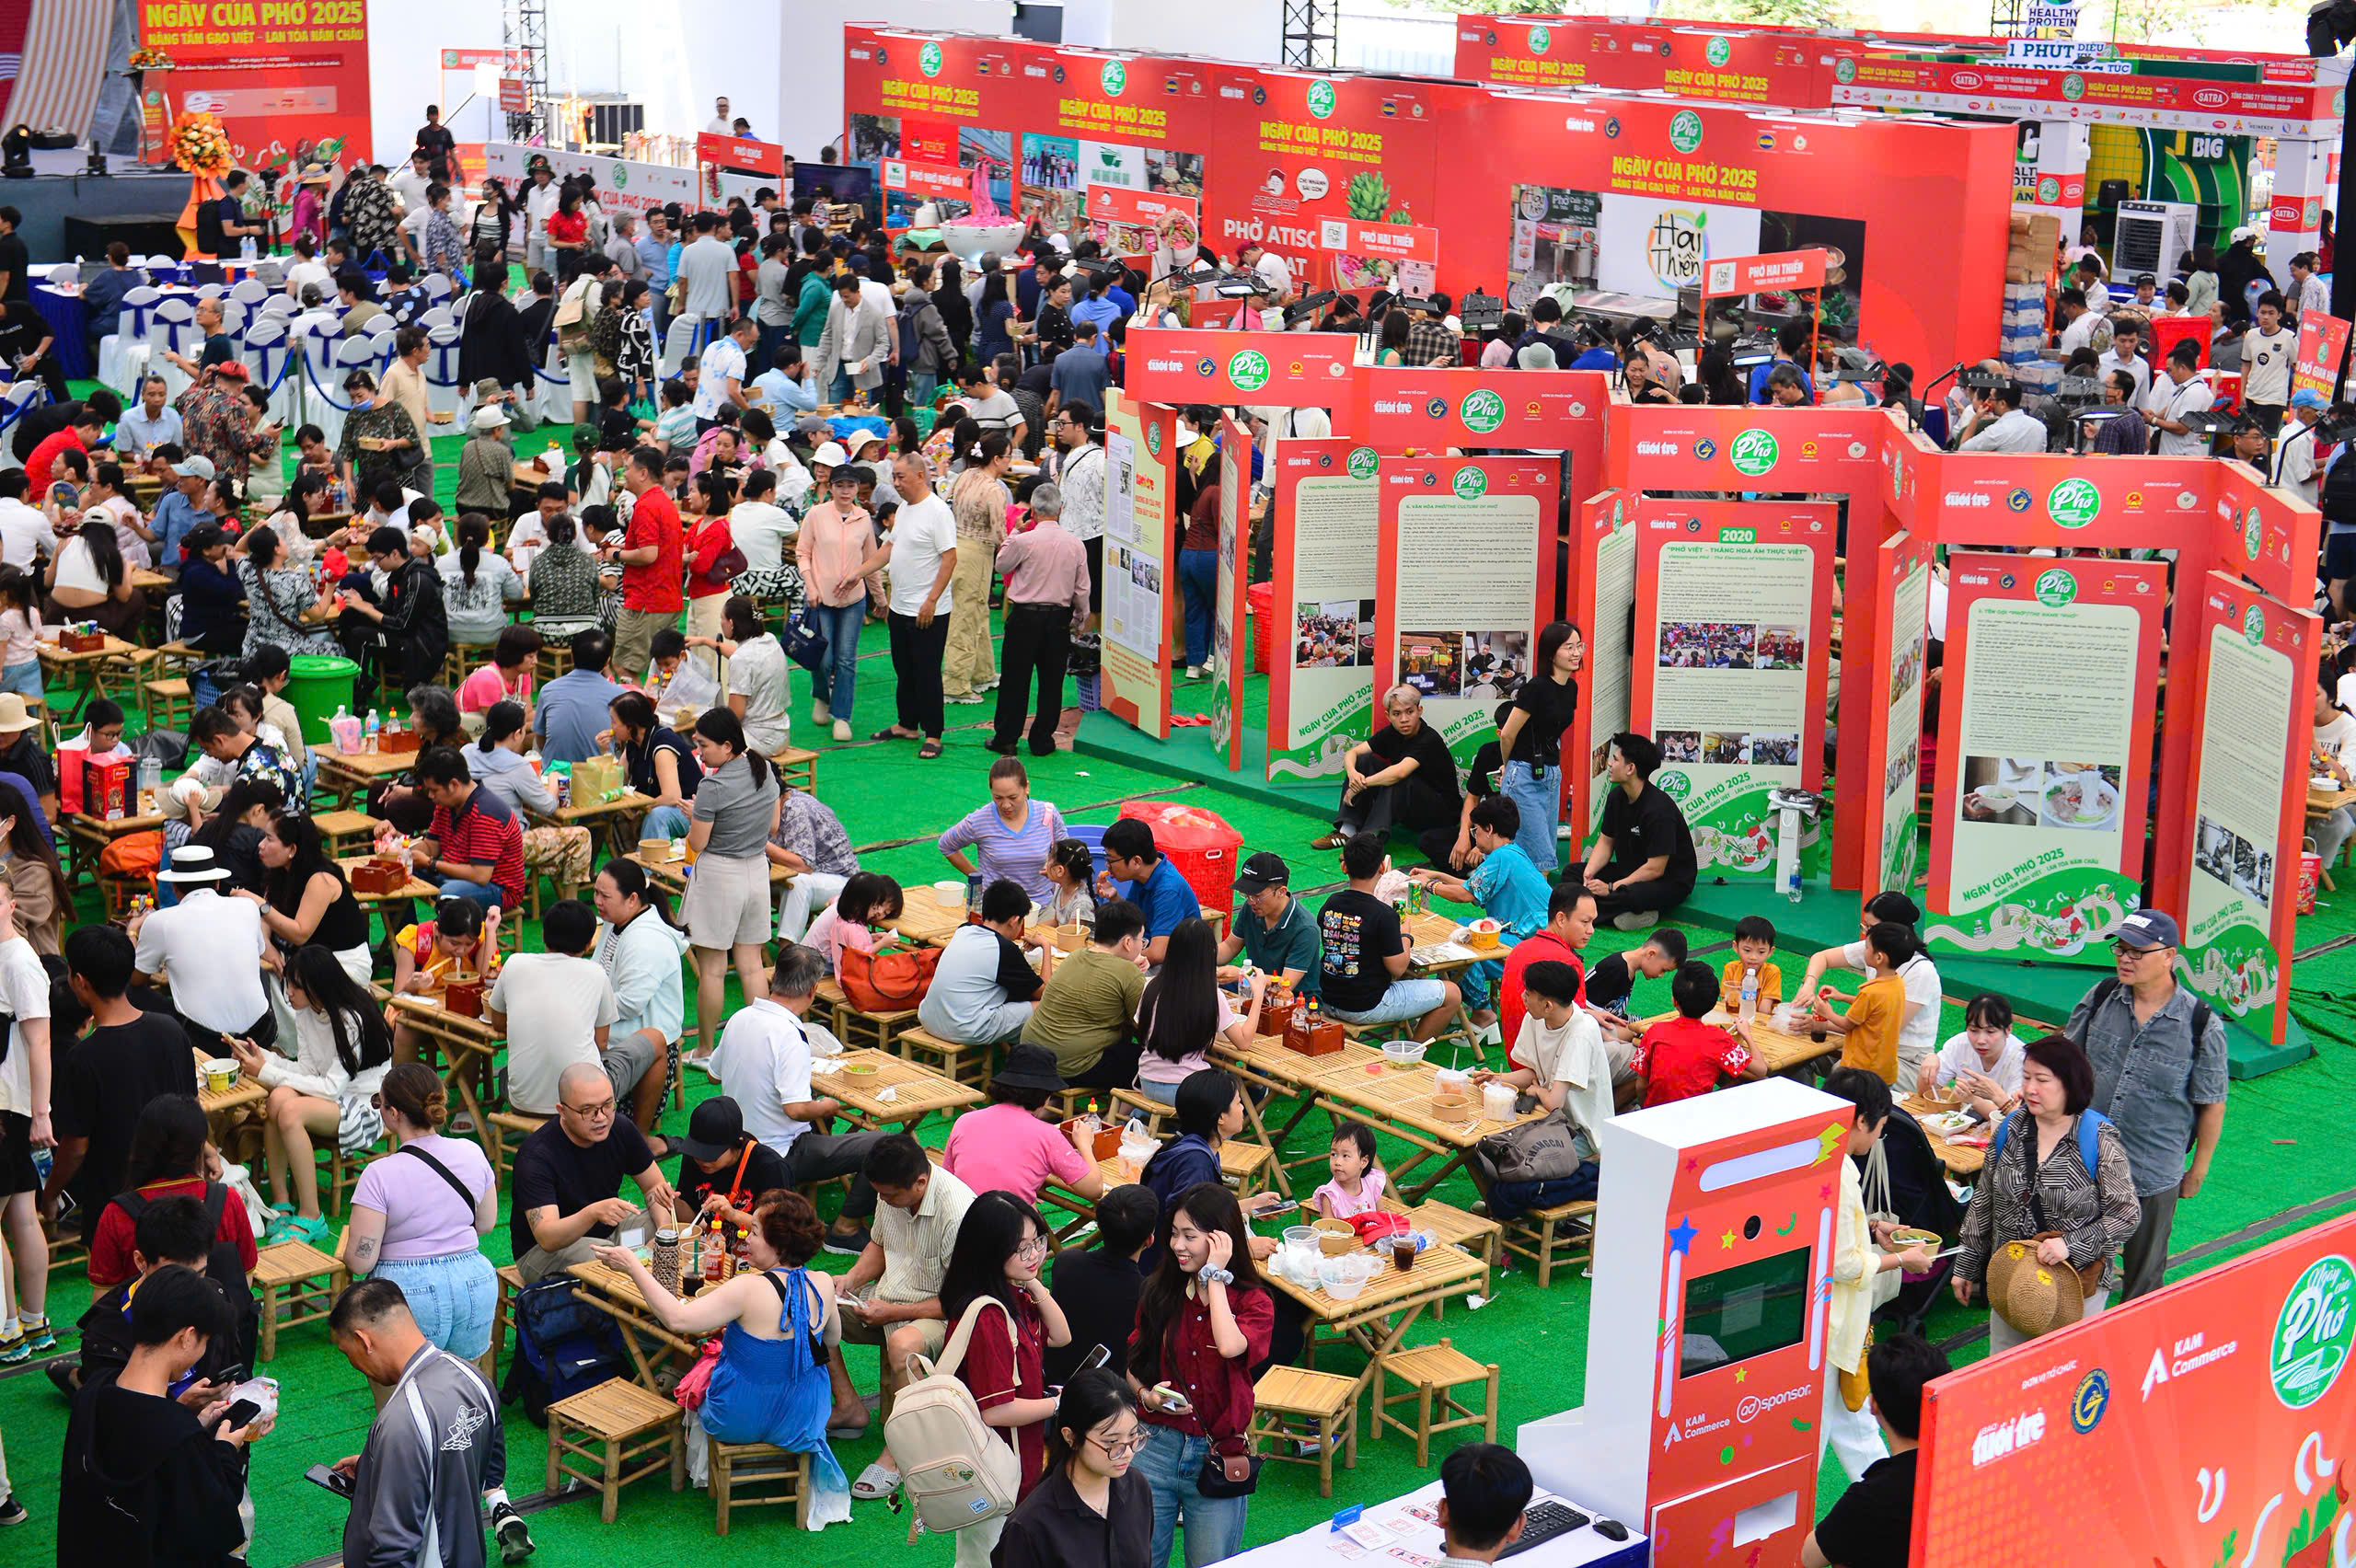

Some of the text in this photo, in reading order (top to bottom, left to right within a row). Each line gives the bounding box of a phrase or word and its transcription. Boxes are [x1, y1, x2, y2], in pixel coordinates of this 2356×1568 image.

[312, 1, 364, 24] 2025
[2028, 8, 2080, 17] HEALTHY
[2028, 17, 2078, 28] PROTEIN
[266, 30, 286, 43] LAN
[2009, 43, 2015, 57] 1
[1562, 63, 1586, 76] 2025
[1742, 75, 1768, 92] 2025
[1955, 75, 1978, 86] SATRA
[2199, 92, 2223, 104] SATRA
[1350, 132, 1382, 152] 2025
[2192, 137, 2224, 159] BIG
[1611, 155, 1757, 190] NGÀY CỦA PHỞ 2025
[2274, 209, 2298, 219] SATRA
[1223, 215, 1264, 242] PHỞ
[1653, 213, 1701, 254] Hai
[1651, 247, 1701, 277] Thiền
[1374, 400, 1396, 414] tuổi
[1466, 398, 1499, 418] Phở
[1637, 441, 1660, 455] tuổi
[1737, 436, 1773, 458] Phở
[1456, 471, 1483, 489] Phở
[1945, 491, 1970, 507] tuổi
[2053, 487, 2095, 509] Phở
[1722, 529, 1753, 542] 2020
[1687, 546, 1703, 554] VIỆT
[2039, 575, 2073, 594] Phở
[1462, 709, 1485, 726] 2025
[1726, 771, 1751, 790] 2025
[2037, 847, 2065, 865] 2025
[2307, 1263, 2342, 1289] Ngày
[2279, 1287, 2352, 1366] Phở
[2173, 1332, 2204, 1358] KAM
[2171, 1340, 2239, 1378] Commerce
[1740, 1397, 1758, 1417] ad
[1684, 1418, 1731, 1439] Commerce
[1685, 1412, 1706, 1428] KAM
[1971, 1407, 2047, 1466] tuổi trẻ
